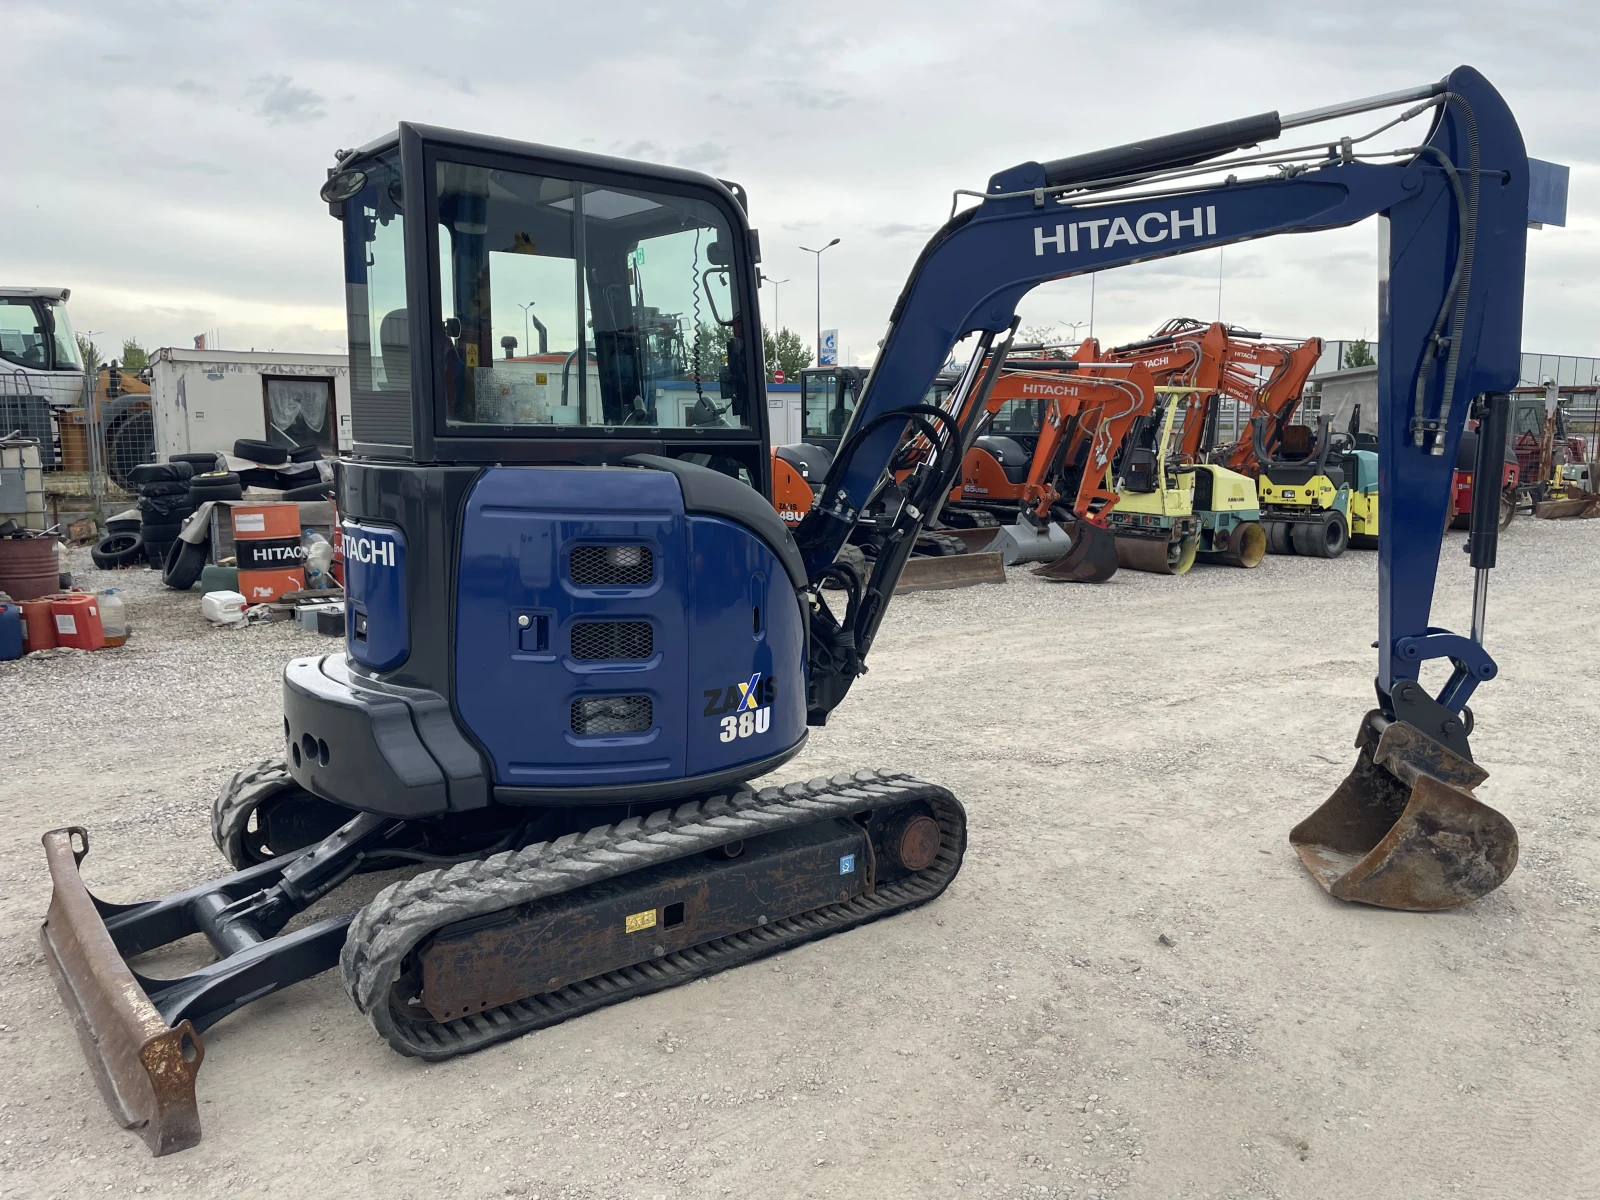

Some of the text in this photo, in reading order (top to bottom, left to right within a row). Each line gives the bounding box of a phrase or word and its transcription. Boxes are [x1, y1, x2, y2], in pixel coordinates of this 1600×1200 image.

[1034, 205, 1216, 256] HITACHI
[1234, 351, 1258, 360] HITACHI
[1023, 384, 1079, 396] HITACHI
[253, 547, 305, 561] HITAC
[342, 533, 395, 567] ITACHI
[704, 672, 778, 717] ZAXIS
[720, 706, 771, 743] 38U
